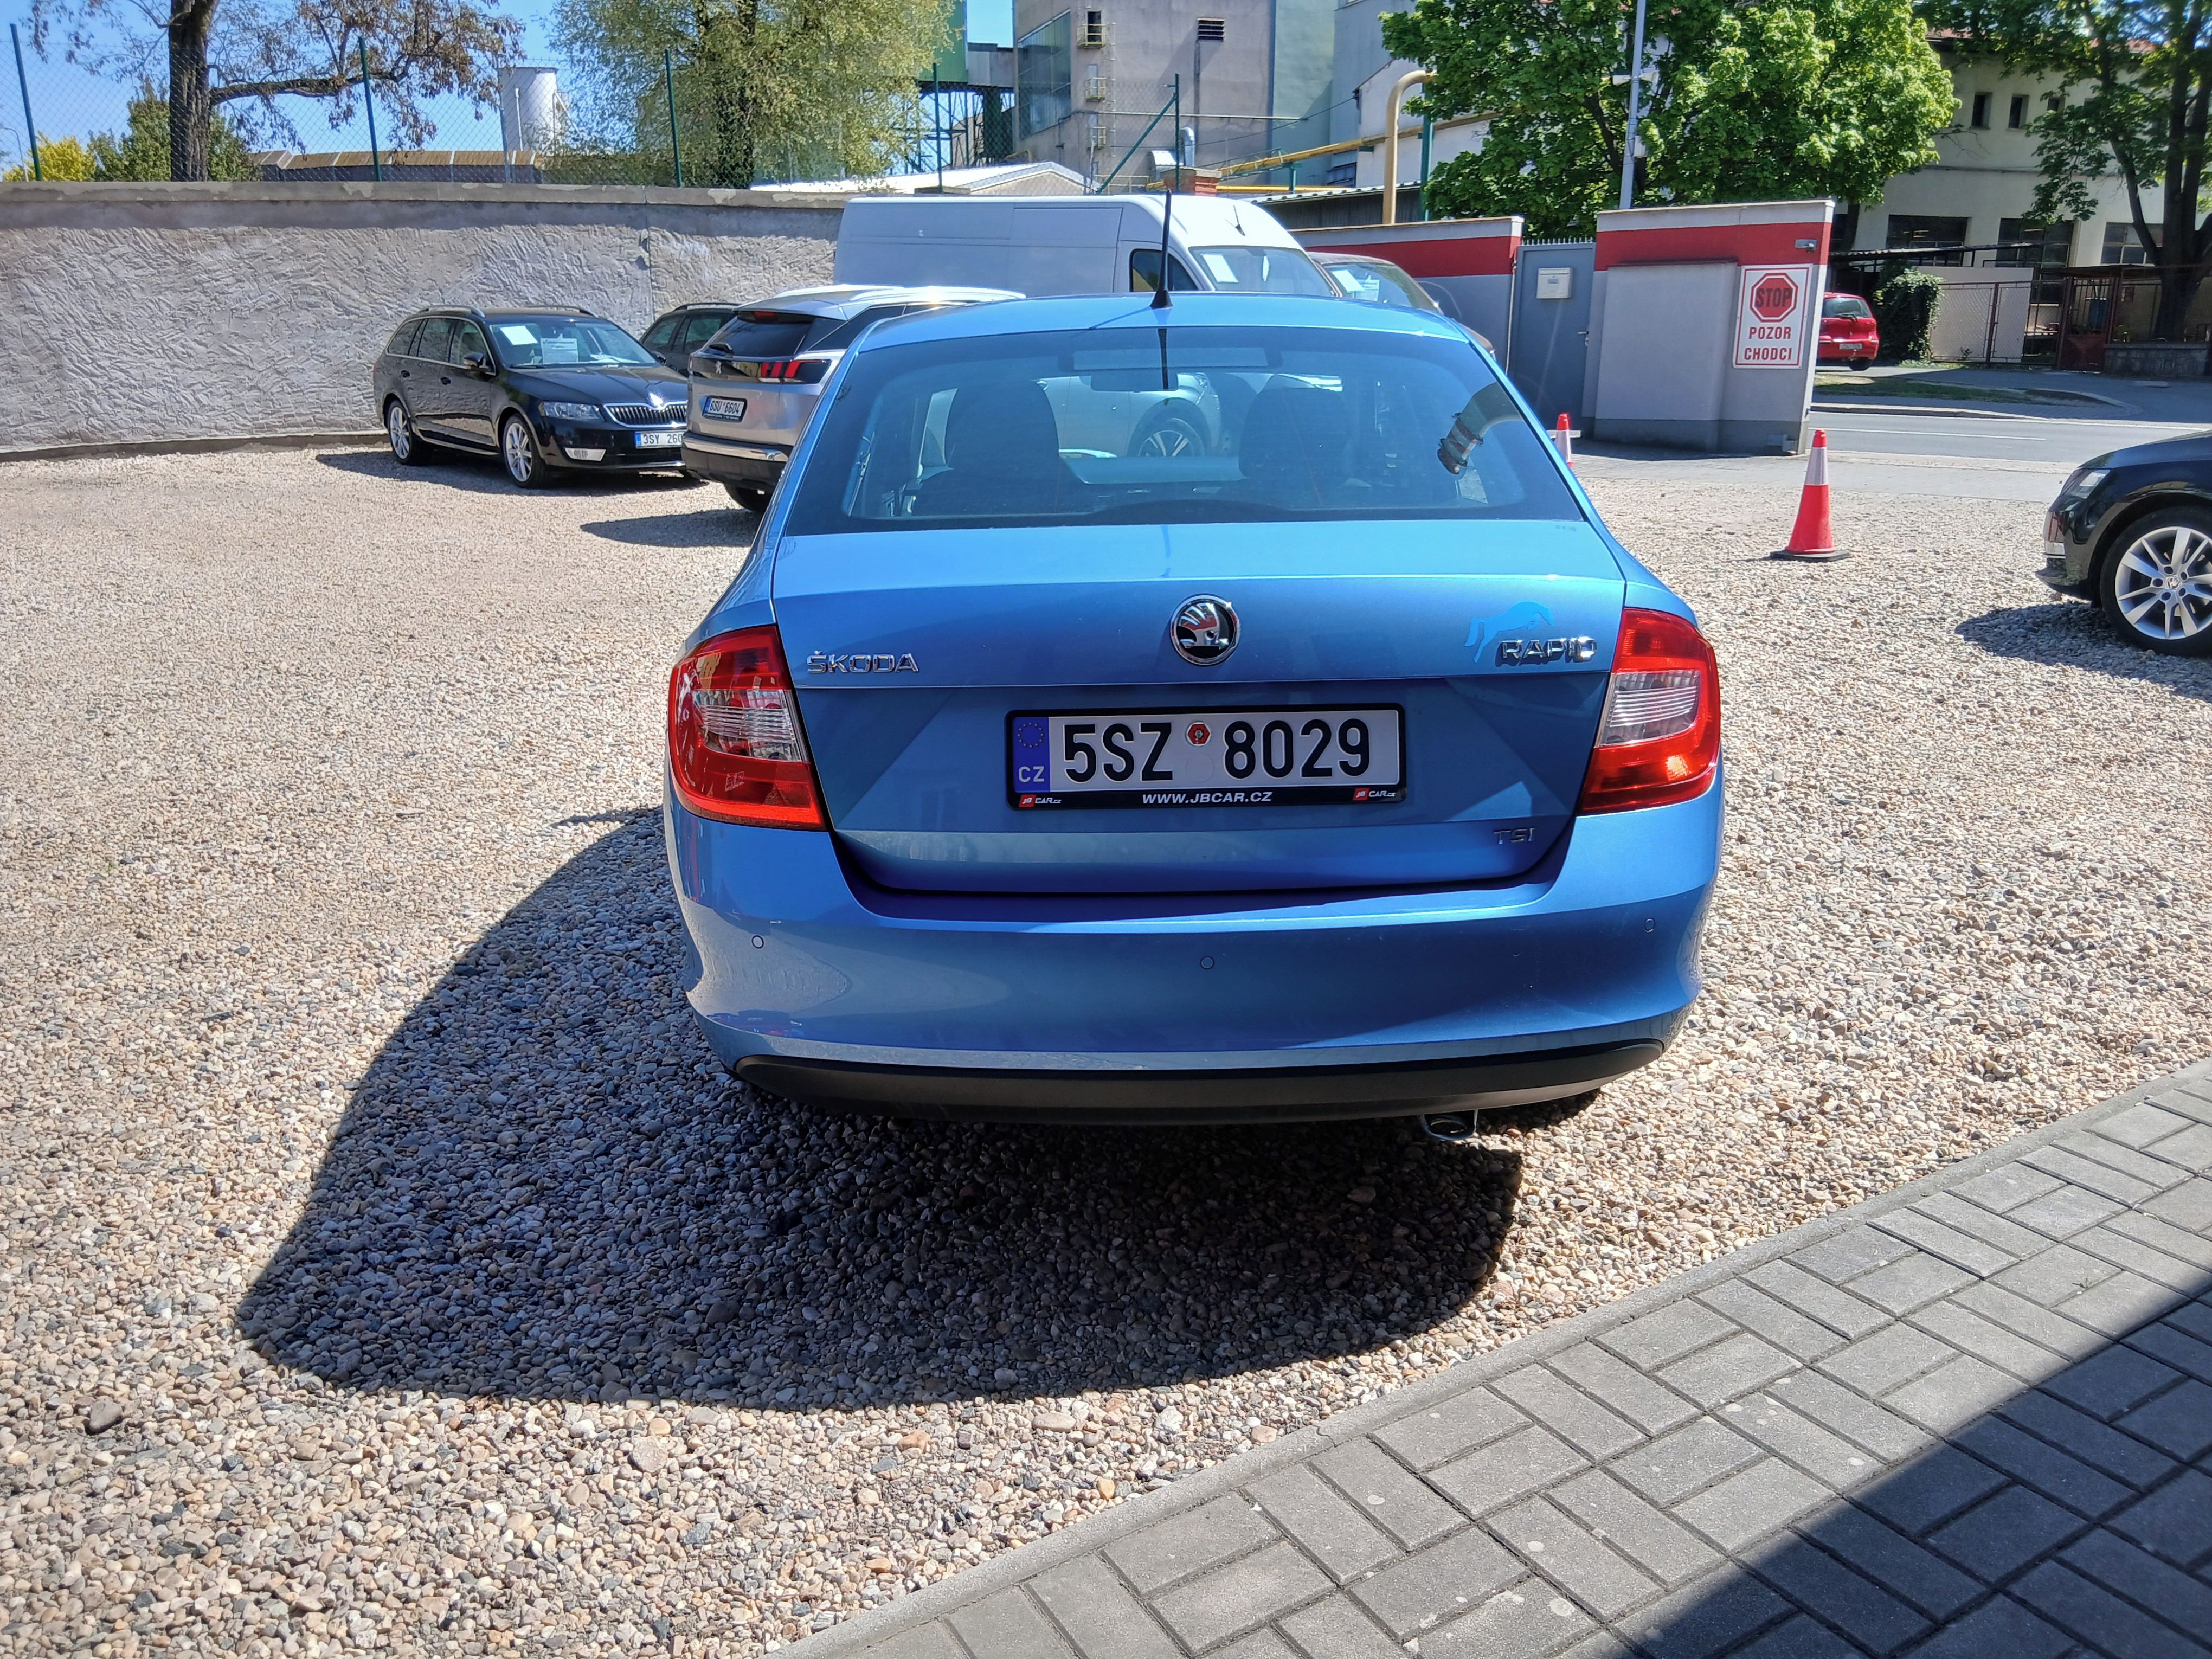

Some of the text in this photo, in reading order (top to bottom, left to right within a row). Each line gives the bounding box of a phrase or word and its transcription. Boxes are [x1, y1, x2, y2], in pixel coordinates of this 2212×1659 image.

[1755, 288, 1792, 307] STOP
[1748, 326, 1791, 339] POZOR
[1744, 348, 1792, 361] CHODCI
[724, 402, 740, 415] 6604
[643, 434, 683, 444] 3SY 260
[1501, 636, 1597, 659] RAPID
[807, 650, 919, 673] ŠKODA
[1063, 718, 1370, 783] 5SZ 8029
[1018, 766, 1045, 782] CZ
[1142, 792, 1273, 804] WWW.JBCAR.CZ
[1493, 828, 1535, 845] TSI
